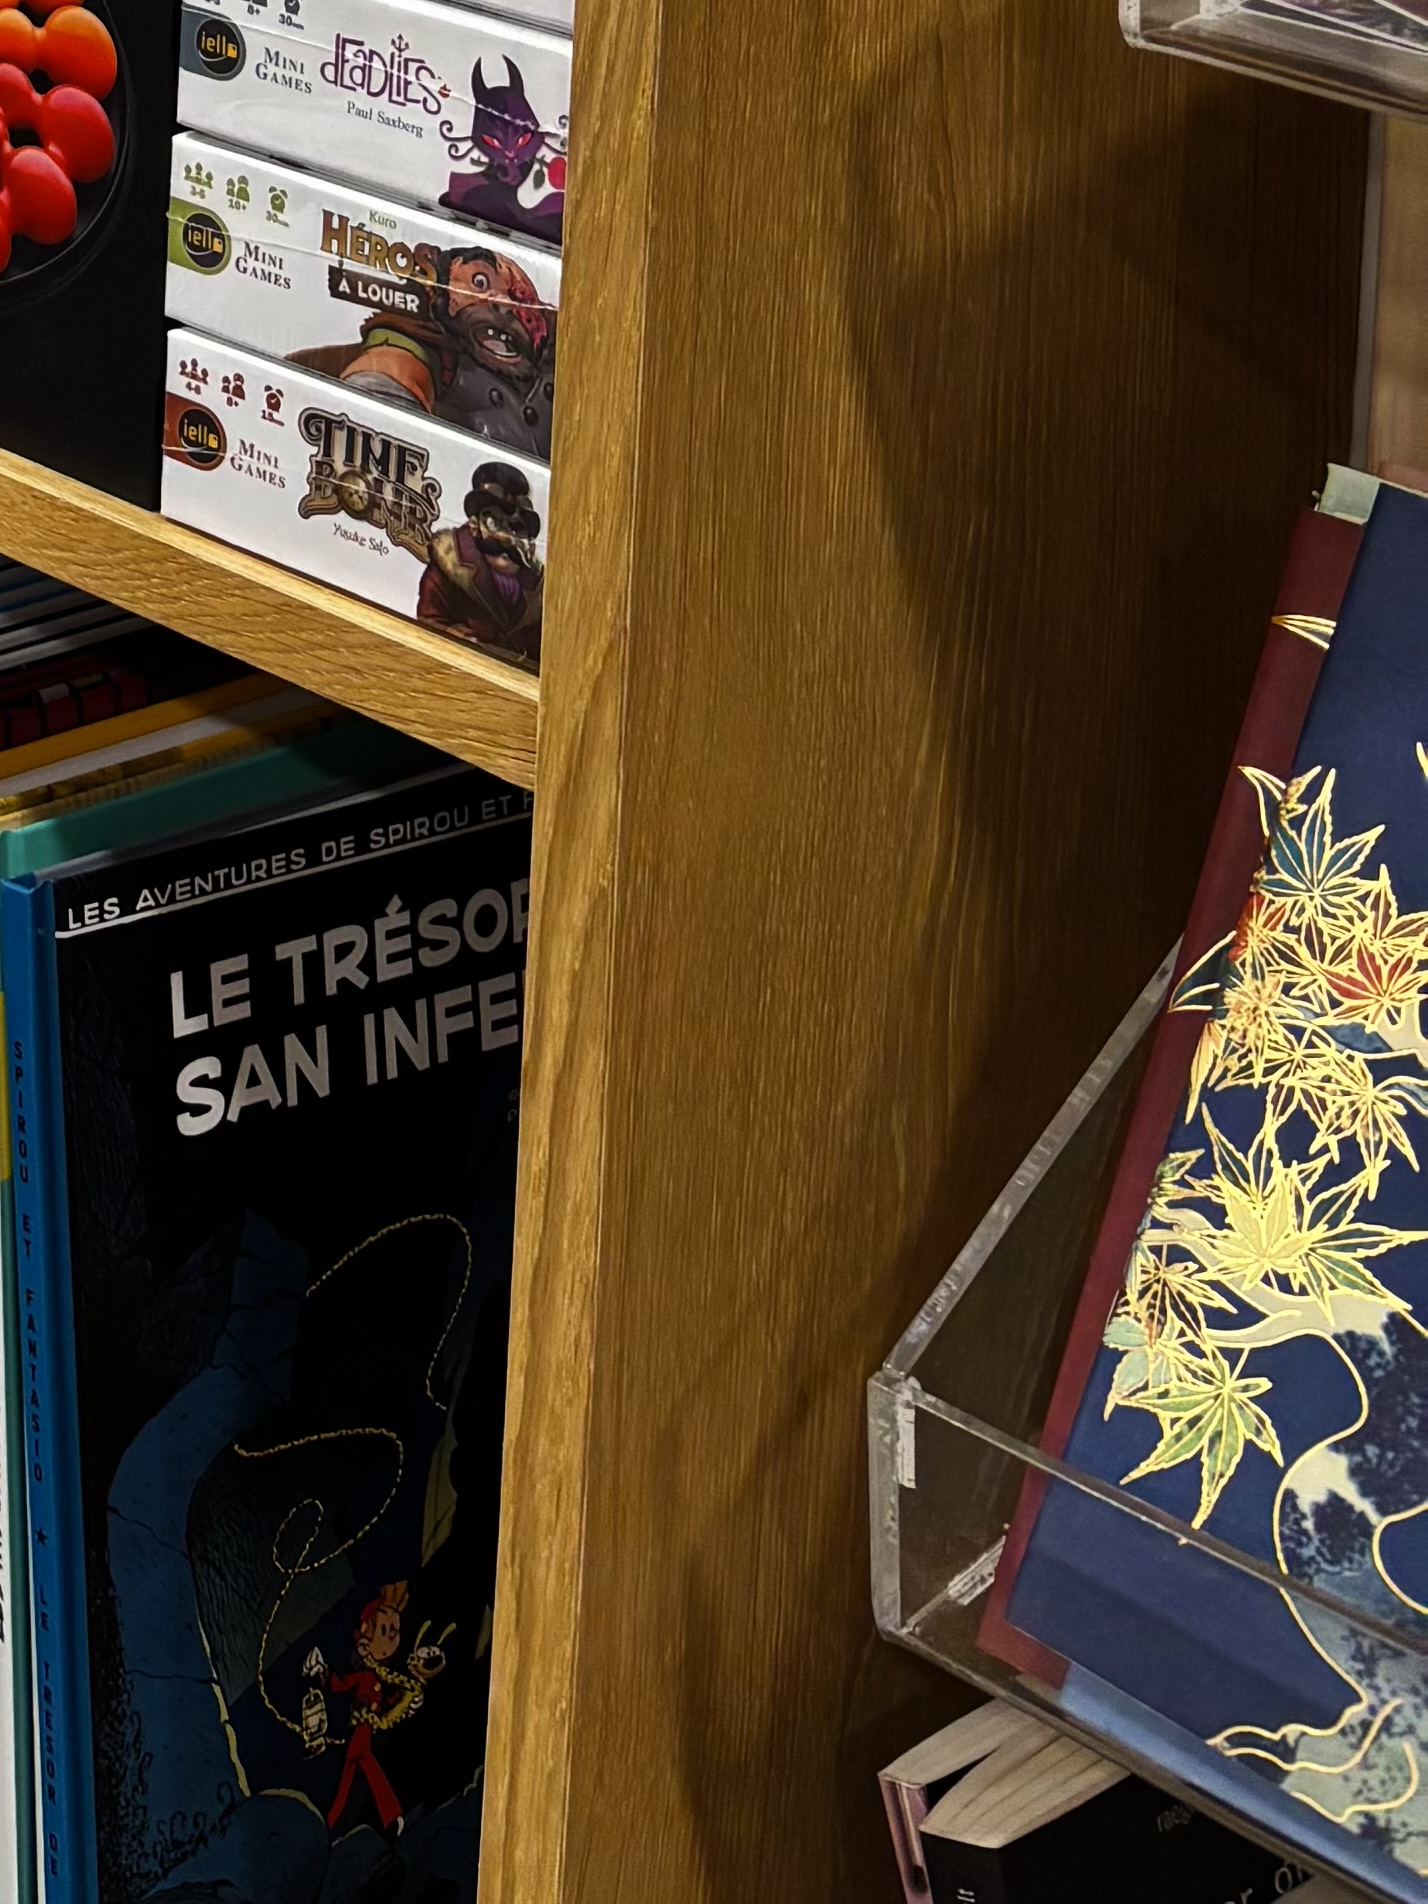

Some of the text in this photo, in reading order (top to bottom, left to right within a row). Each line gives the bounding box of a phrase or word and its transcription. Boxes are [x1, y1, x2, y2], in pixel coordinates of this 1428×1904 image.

[347, 101, 424, 138] Paul Saxberg
[320, 207, 438, 283] HÉROS
[369, 209, 398, 230] Kuro
[357, 279, 420, 314] LOUER
[67, 794, 512, 931] LES AVENTURES DE SPIROU ET
[169, 953, 253, 1039] LE
[175, 971, 526, 1137] SAN INFE
